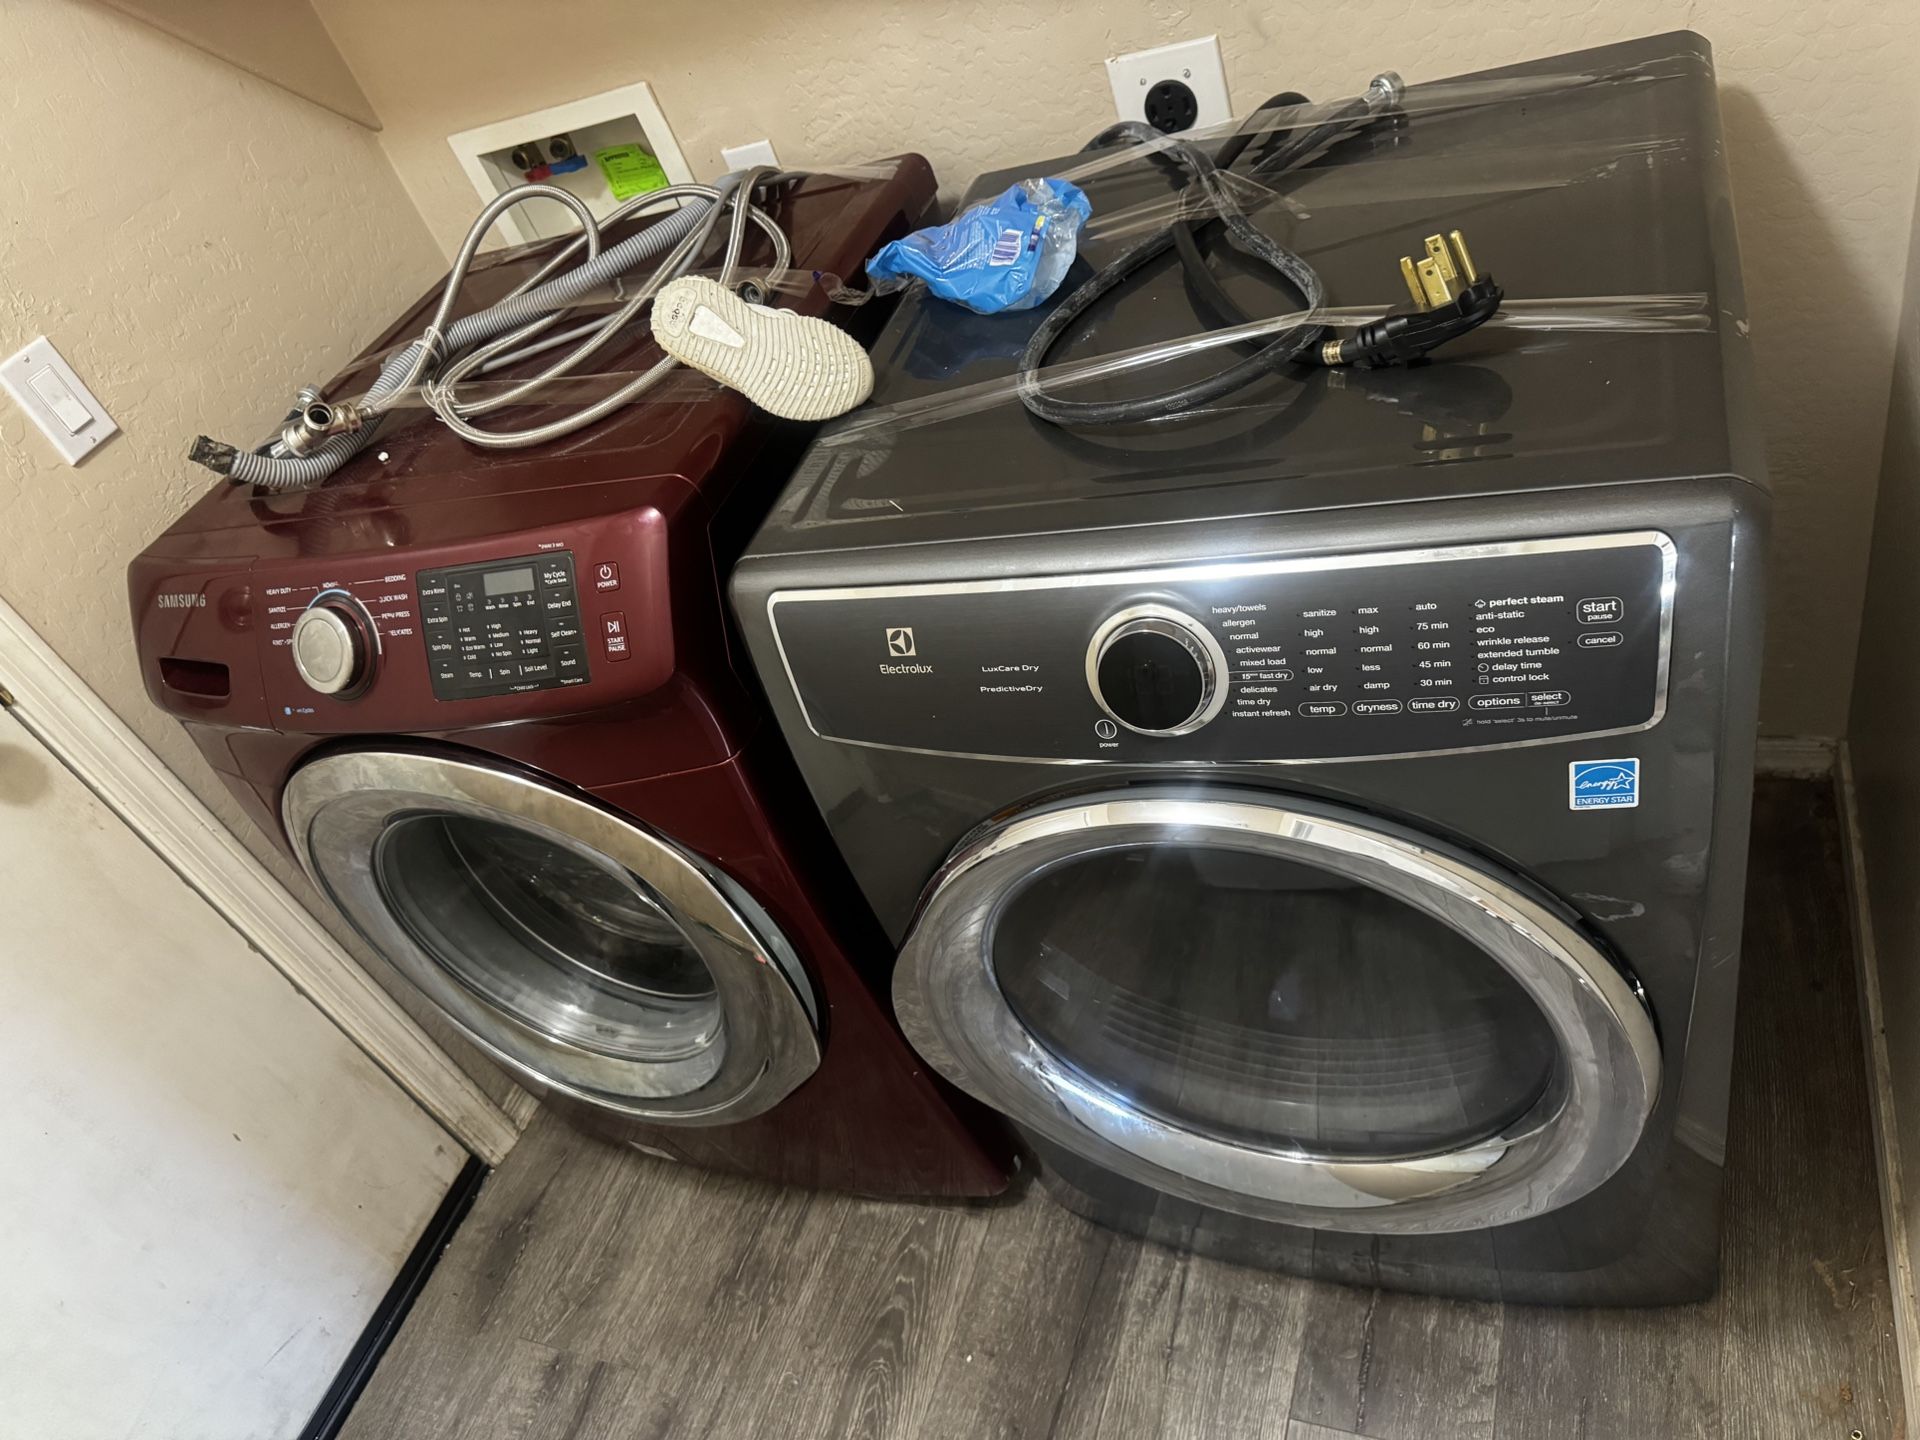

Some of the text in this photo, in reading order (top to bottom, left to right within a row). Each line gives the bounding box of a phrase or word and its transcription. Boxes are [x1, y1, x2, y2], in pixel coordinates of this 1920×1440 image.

[384, 574, 406, 583] BEDDING
[544, 570, 566, 580] My Cycle
[597, 579, 618, 588] POWER
[280, 587, 291, 595] DUTY
[158, 594, 206, 608] SAMSUNG
[393, 593, 408, 601] WASH
[1489, 594, 1564, 608] perfect steam
[1211, 603, 1267, 615] heavy/towels
[1358, 606, 1379, 615] max
[1415, 602, 1437, 611] auto
[1582, 600, 1617, 614] start
[1302, 608, 1337, 618] sanitize
[1475, 609, 1525, 621] anti-static
[1587, 612, 1613, 622] pause
[1222, 618, 1256, 628] allergen
[1416, 621, 1449, 630] 75 min
[1304, 628, 1324, 638] high
[1359, 625, 1379, 635] high
[1476, 626, 1495, 634] eco
[1229, 631, 1259, 640] normal
[1477, 634, 1550, 647] wrinkle release
[1584, 635, 1617, 645] cancel
[1235, 645, 1281, 654] activewear
[1360, 643, 1393, 653] normal
[1417, 640, 1450, 650] 60 min
[1305, 647, 1337, 656] normal
[1478, 646, 1560, 659] extended tumble
[560, 659, 576, 667] Sound
[1240, 657, 1287, 667] mixed load
[1433, 659, 1451, 668] min
[1492, 660, 1542, 672] delay time
[879, 663, 933, 674] Electrolux
[981, 664, 1040, 673] LuxCare Dry
[1307, 666, 1324, 674] low
[1361, 663, 1381, 672] less
[1259, 672, 1274, 680] fast
[1275, 671, 1288, 681] dry
[1492, 672, 1550, 683] control lock
[1363, 681, 1390, 691] damp
[1420, 678, 1452, 687] 30 min
[980, 684, 1043, 693] PredictiveDry
[1240, 685, 1278, 694] delicates
[1309, 683, 1338, 693] air dry
[1237, 697, 1271, 706] time dry
[1531, 692, 1562, 701] select
[1356, 701, 1399, 713] dryness
[1411, 699, 1456, 711] time dry
[1477, 697, 1521, 707] options
[1232, 709, 1291, 718] instant refresh
[1309, 704, 1336, 715] temp
[1099, 741, 1119, 749] power
[1576, 795, 1633, 806] ENERGY STAR
